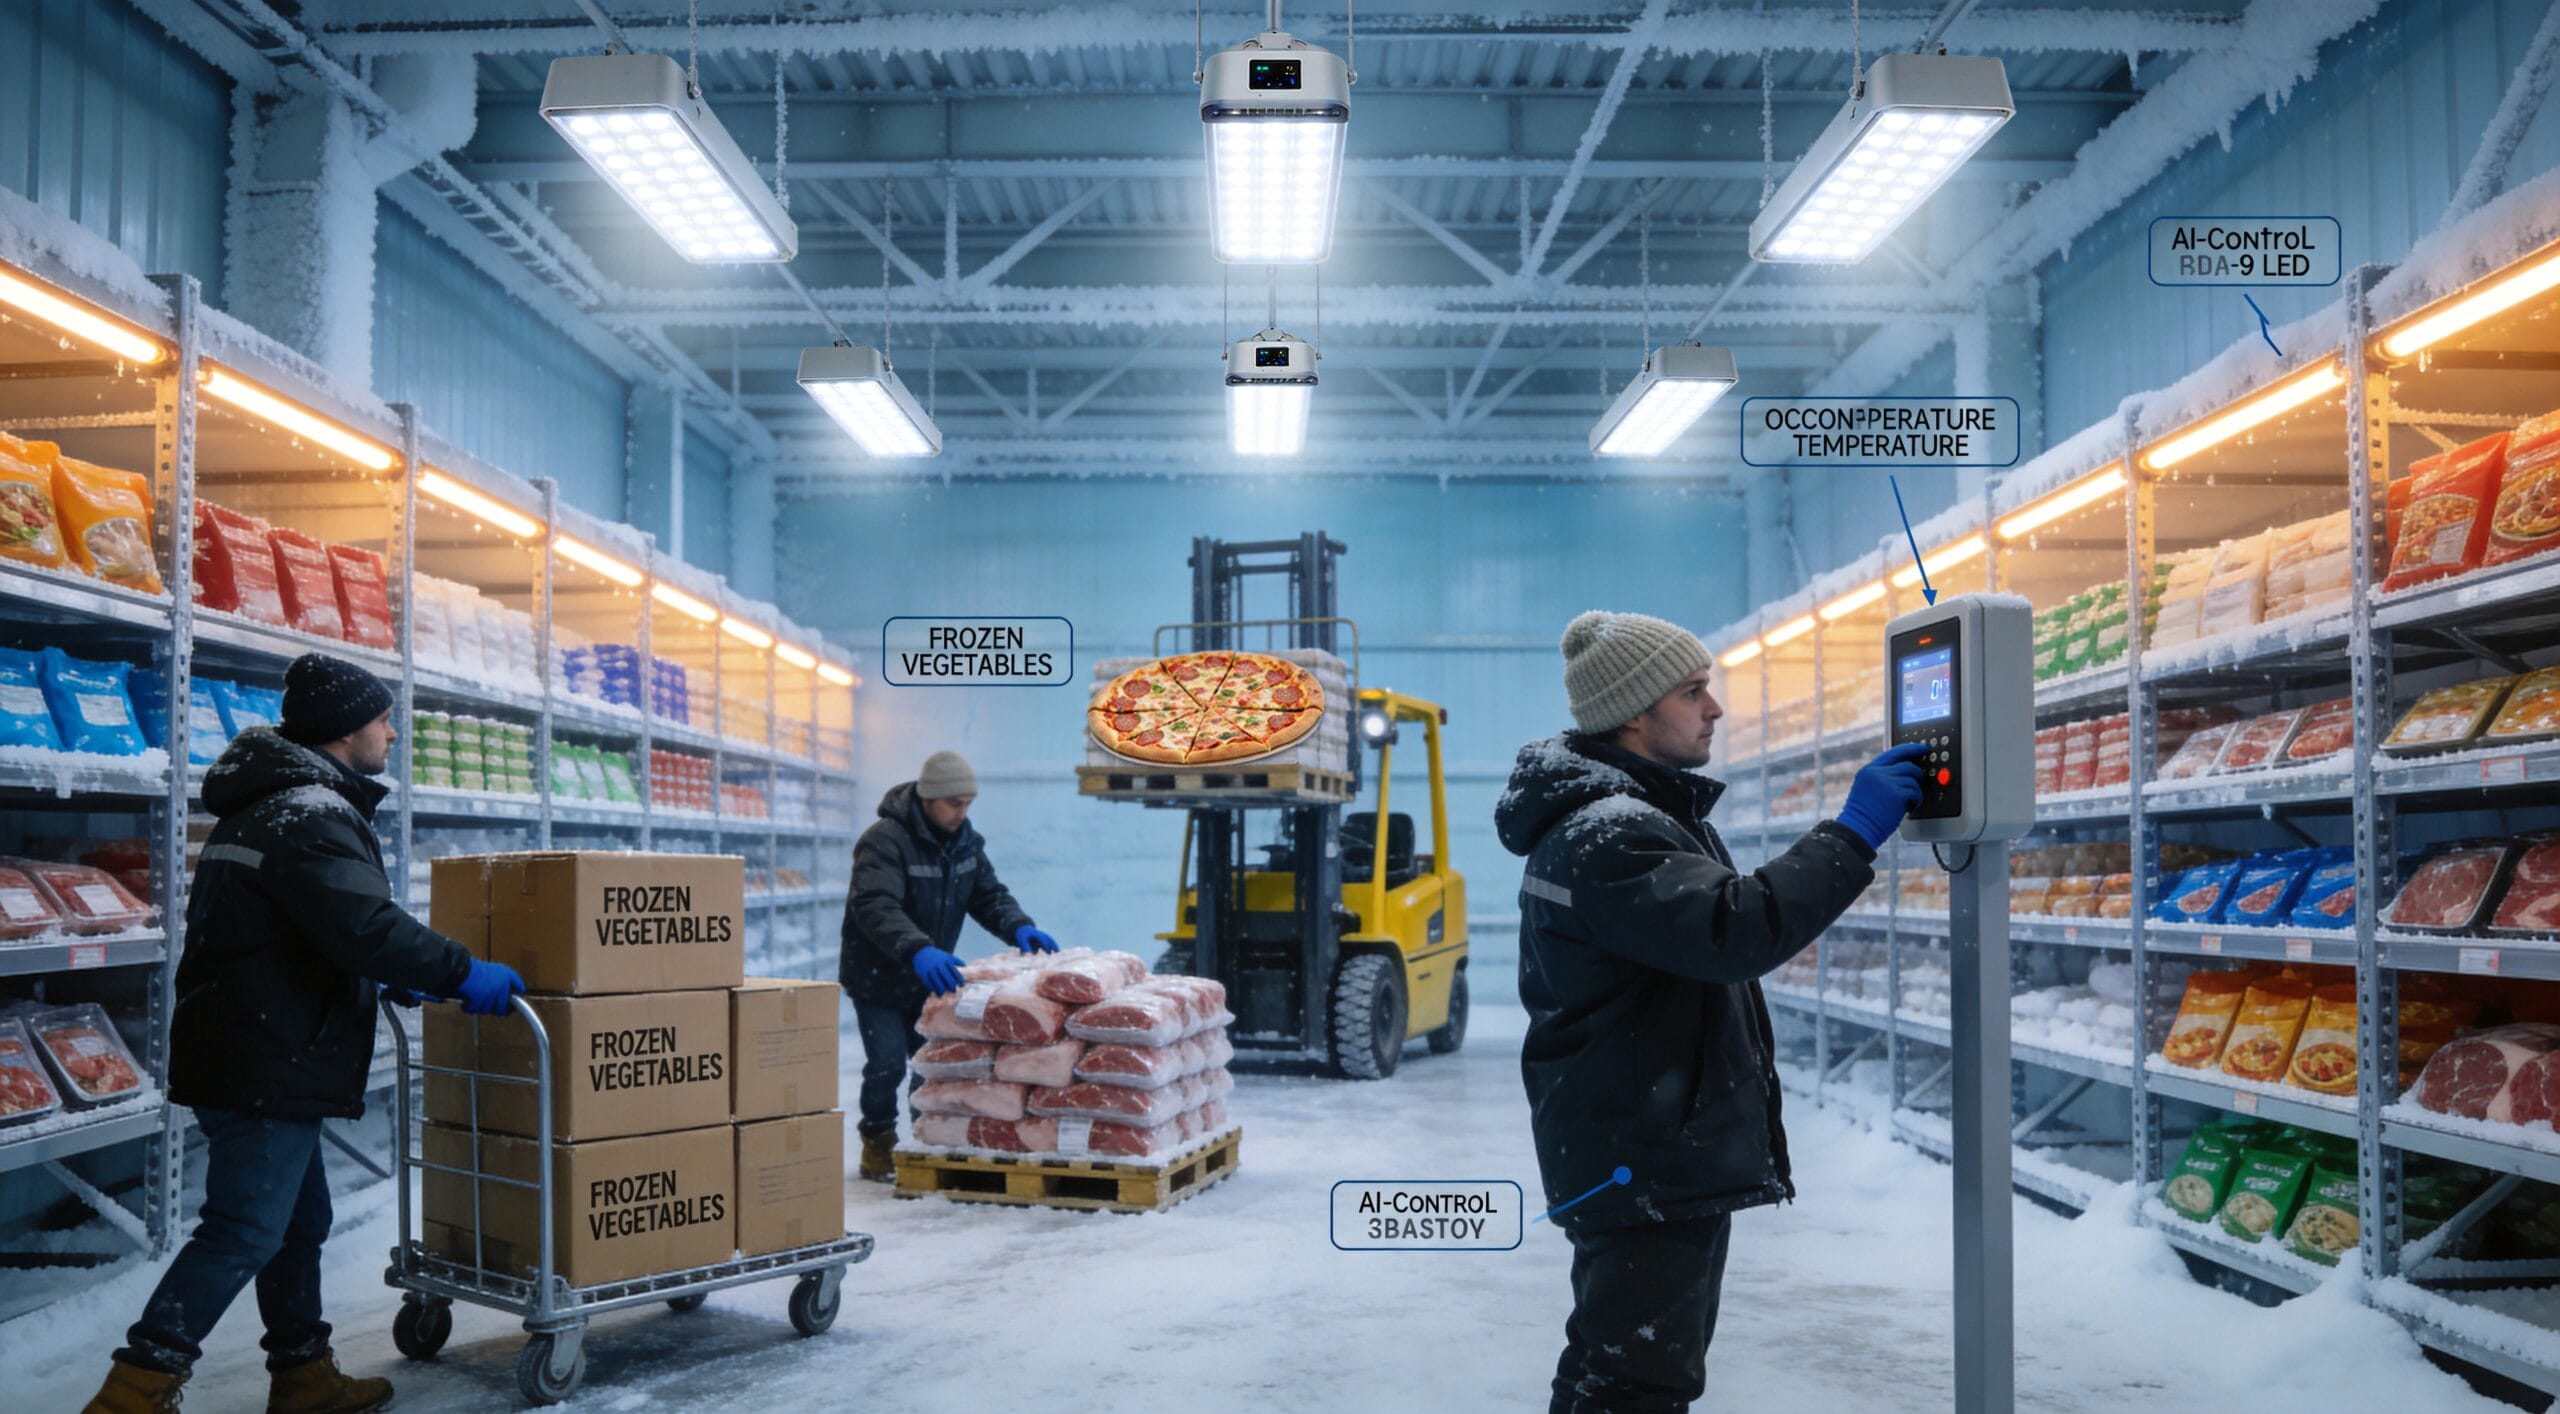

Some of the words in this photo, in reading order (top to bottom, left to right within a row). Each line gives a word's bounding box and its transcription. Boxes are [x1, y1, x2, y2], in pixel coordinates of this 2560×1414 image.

[603, 885, 691, 914] FROZEN
[595, 915, 732, 947] VEGETABLES
[591, 1026, 676, 1060] FROZEN
[589, 1052, 723, 1092] VEGETABLES
[590, 1169, 677, 1209] FROZEN
[588, 1193, 725, 1241] VEGETABLES
